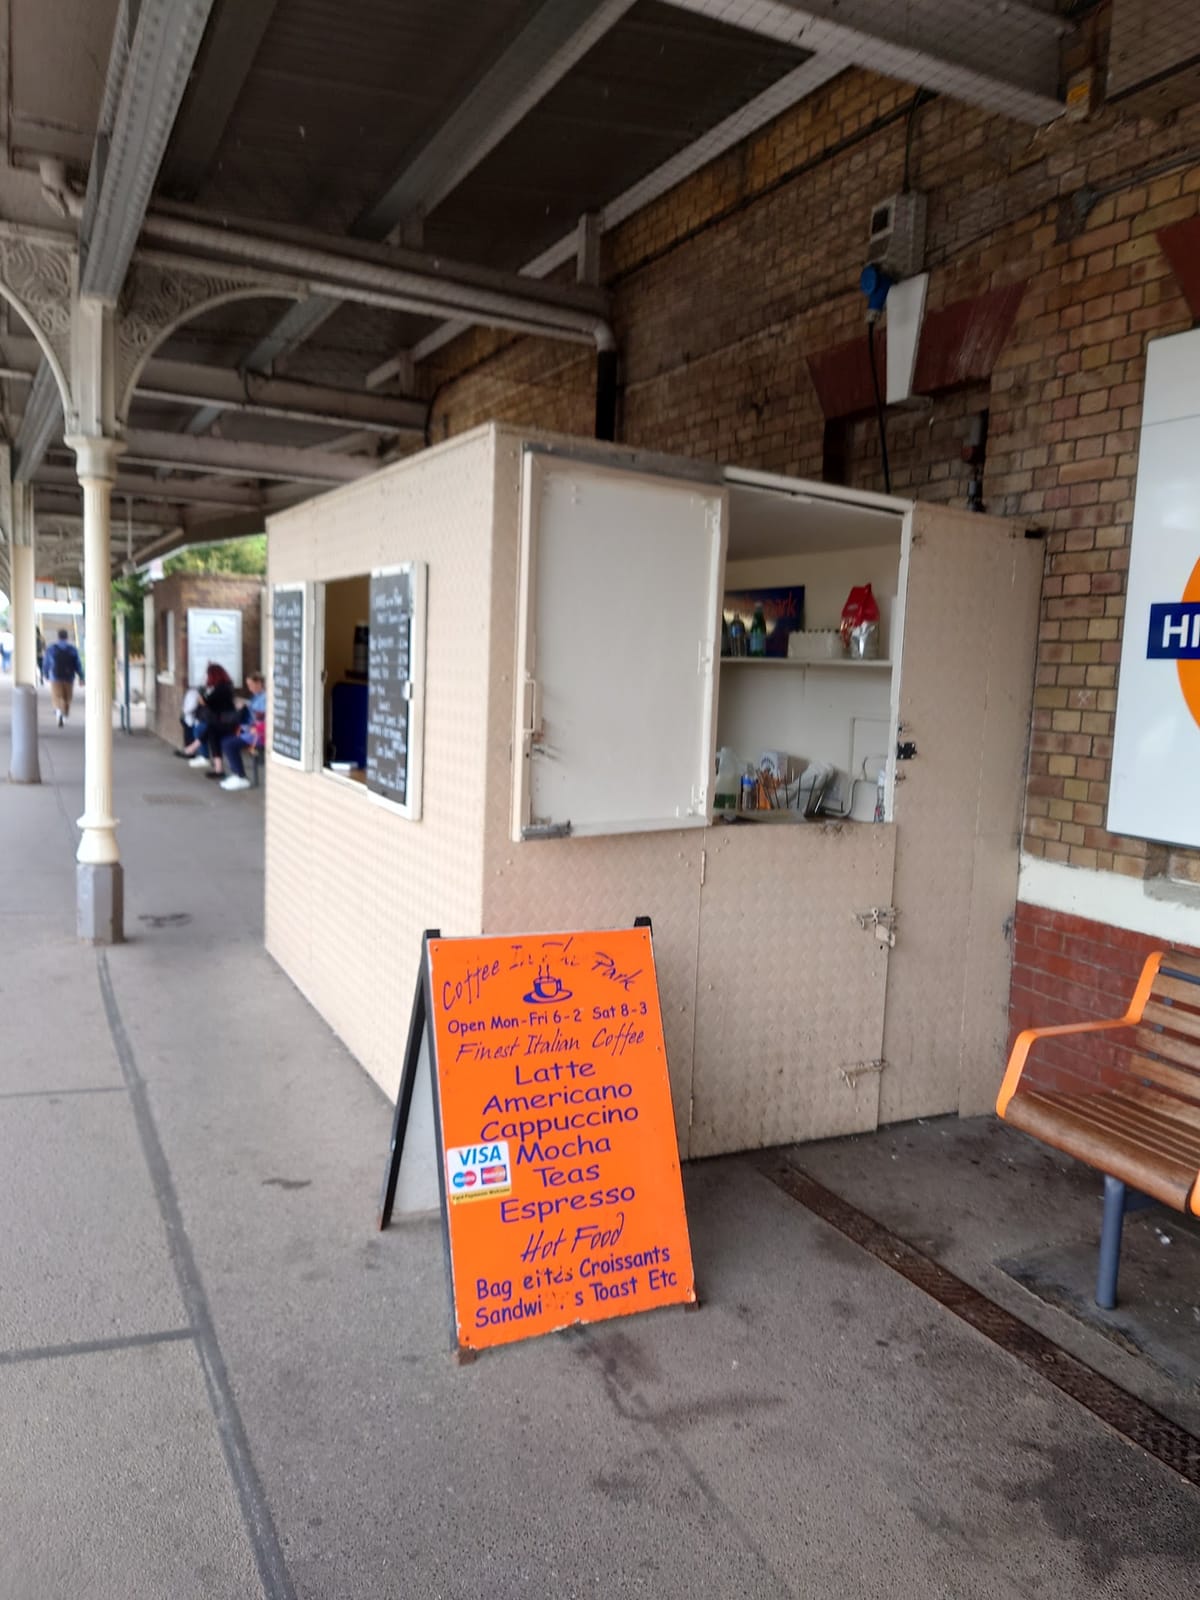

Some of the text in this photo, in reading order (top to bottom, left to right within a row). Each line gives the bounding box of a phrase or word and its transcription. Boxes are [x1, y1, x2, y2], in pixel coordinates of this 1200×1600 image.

[443, 959, 500, 1011] Coffee
[592, 952, 643, 991] Park
[448, 1019, 485, 1036] Open
[592, 1006, 616, 1020] Sat
[456, 1022, 645, 1062] Finest Italian Coffee
[515, 1060, 596, 1085] Latte
[482, 1083, 633, 1115] Americano
[480, 1106, 639, 1142] Cappuccino
[458, 1145, 501, 1166] VISA
[516, 1135, 611, 1165] Mocha
[533, 1164, 600, 1187] Teas
[500, 1186, 635, 1223] Espresso
[521, 1212, 625, 1262] Hot Food
[580, 1247, 670, 1278] Croissants
[475, 1269, 678, 1328] Sandwis Toast Etc
